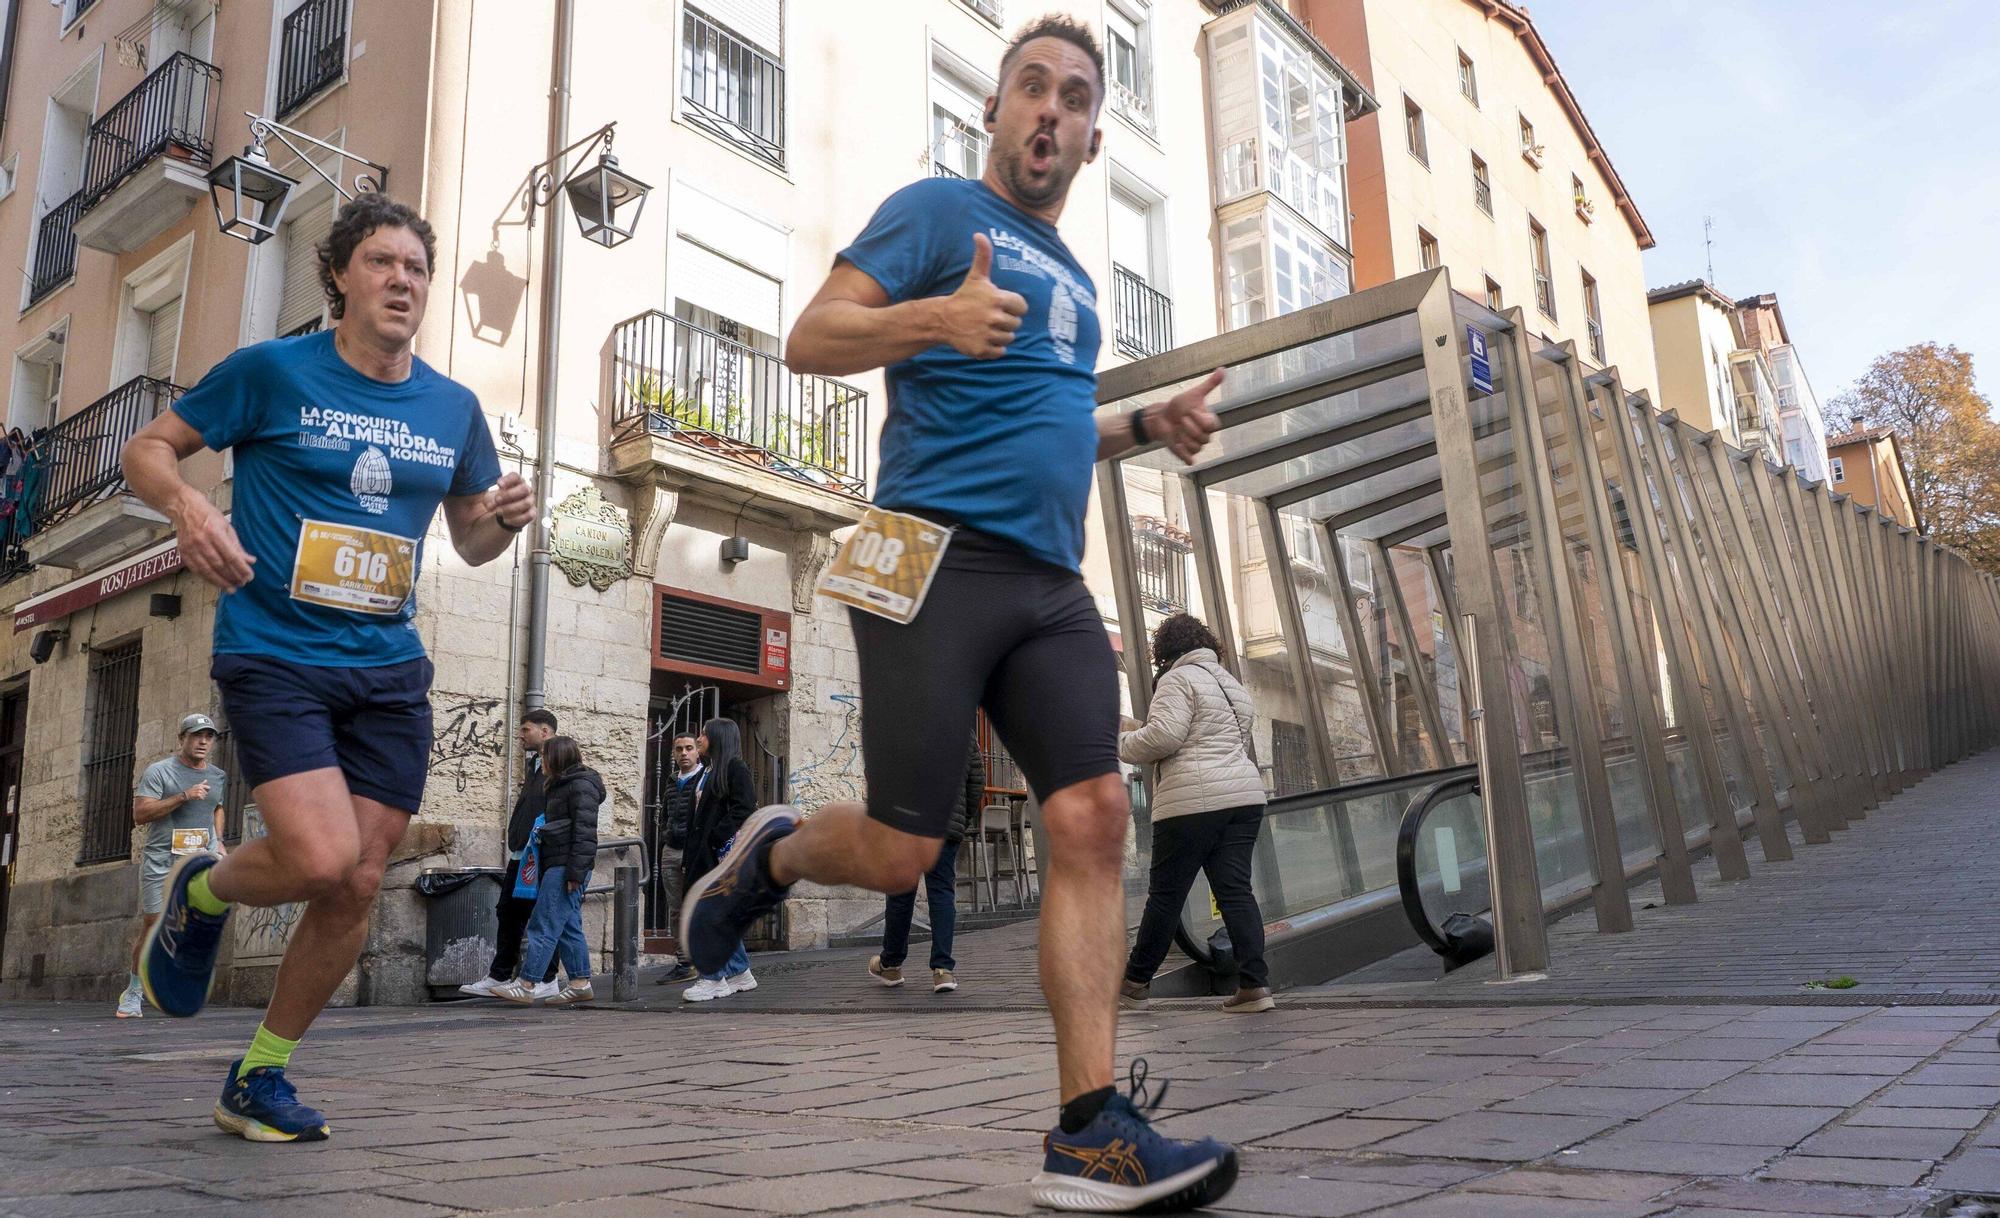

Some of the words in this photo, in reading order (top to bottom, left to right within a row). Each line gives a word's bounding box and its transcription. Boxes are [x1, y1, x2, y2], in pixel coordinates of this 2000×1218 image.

[301, 406, 321, 419] LA
[322, 408, 411, 434] CONQUISTA
[301, 418, 314, 426] DE
[316, 418, 328, 427] LA
[325, 421, 440, 453] ALMENDRA
[390, 446, 455, 469] KONKISTA
[559, 538, 569, 549] DE
[572, 541, 583, 553] LA
[100, 570, 126, 596] ROSI
[124, 548, 182, 590] JATETXEA
[333, 545, 389, 583] 616
